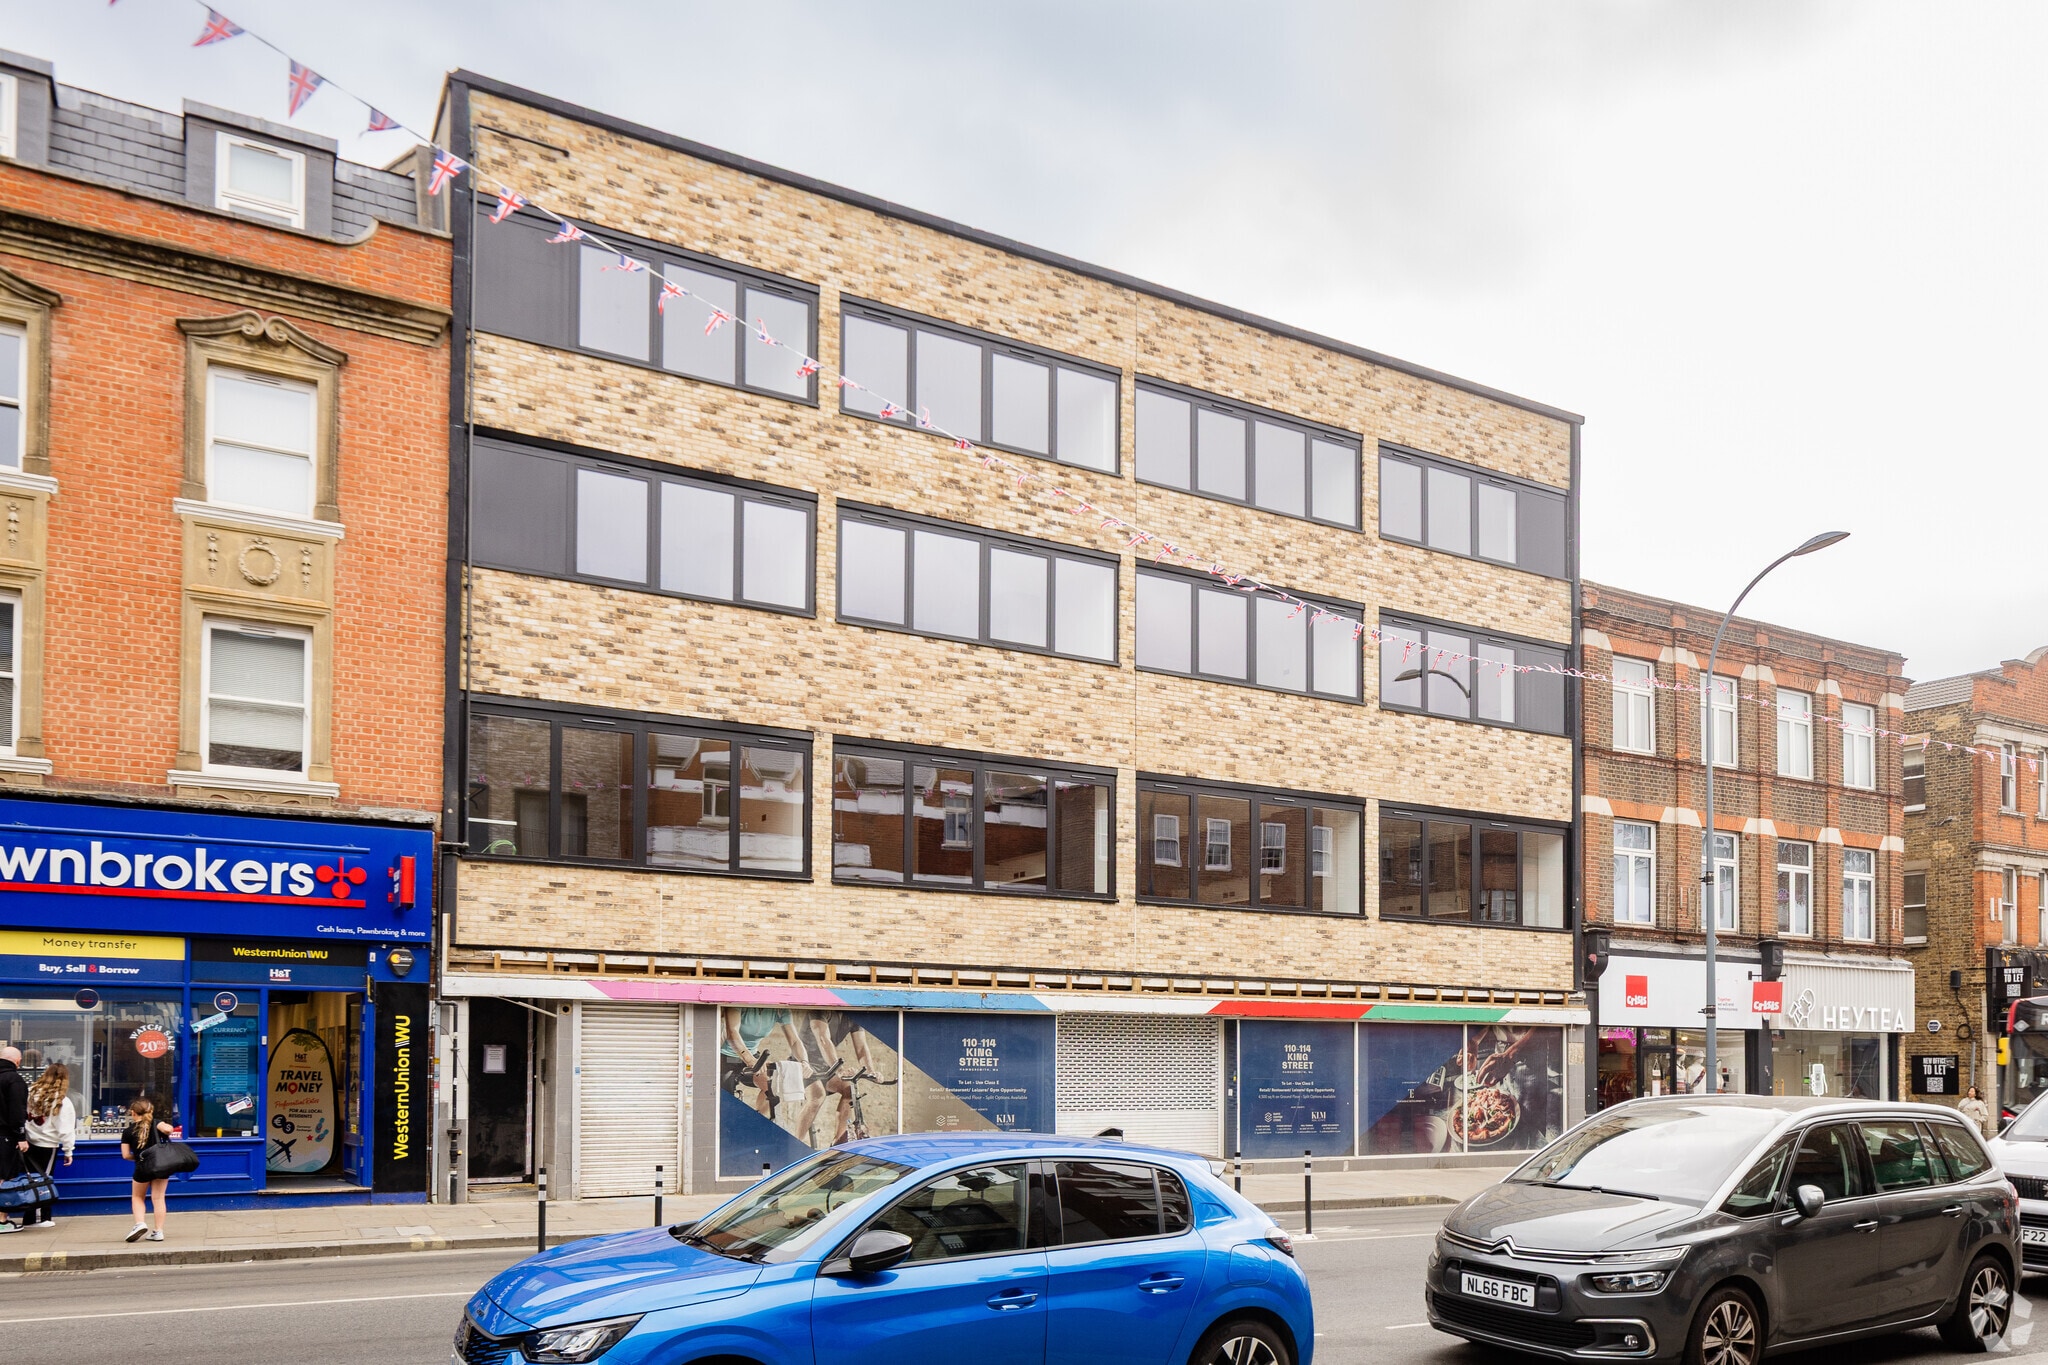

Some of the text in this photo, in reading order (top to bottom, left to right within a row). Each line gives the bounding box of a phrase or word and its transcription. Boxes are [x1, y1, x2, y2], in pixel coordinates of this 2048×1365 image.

[316, 925, 335, 933] Cash
[336, 926, 356, 935] loans,
[356, 926, 399, 938] Pawnbroking
[43, 938, 138, 950] Money transfer
[39, 964, 140, 975] Buy, Sell & Borrow
[269, 968, 291, 978] H&T
[2004, 974, 2023, 982] TO LET
[1823, 1006, 1906, 1030] HEYTEA
[129, 1024, 162, 1039] WATCH
[966, 1048, 993, 1057] KING
[1287, 1053, 1309, 1061] KING
[959, 1058, 999, 1067] STREET
[1282, 1062, 1313, 1070] STREET
[280, 1070, 323, 1081] TRAVEL
[1923, 1065, 1946, 1075] TO LET
[275, 1082, 323, 1094] MONEY
[393, 1048, 410, 1160] WesternUnion
[1467, 1277, 1528, 1303] NL66 FBC
